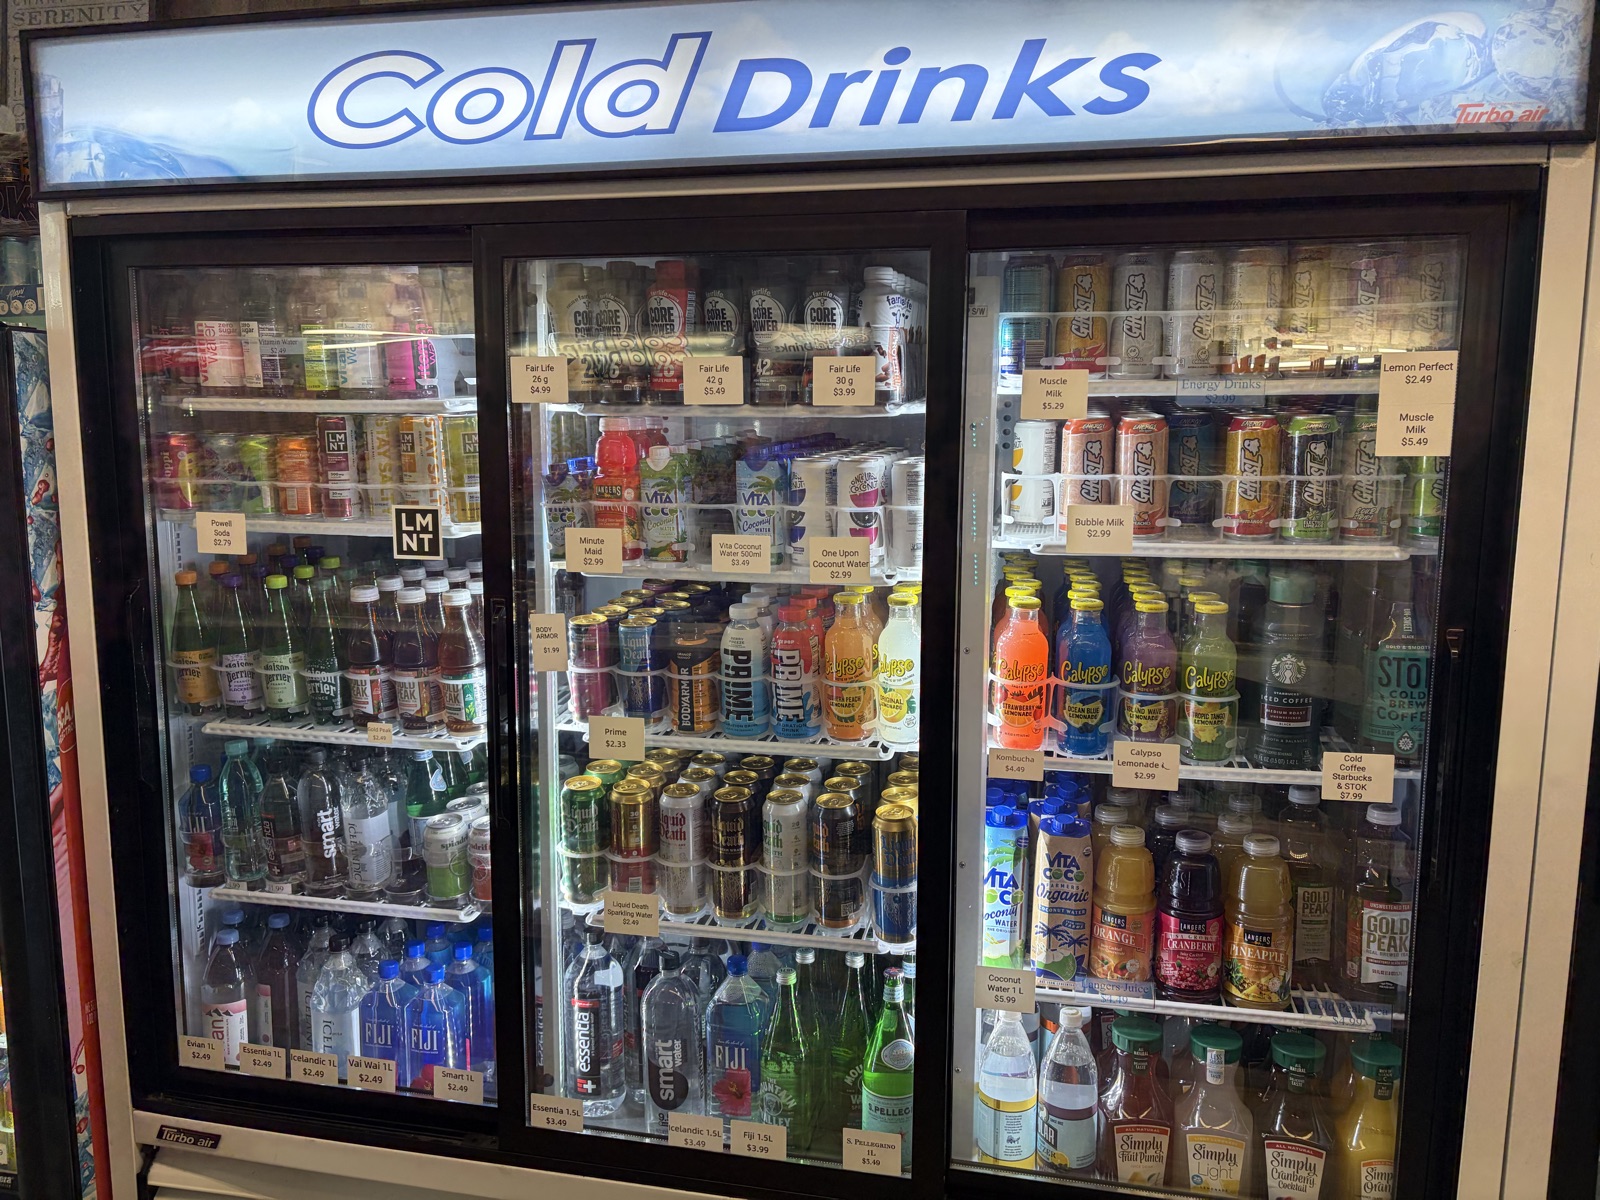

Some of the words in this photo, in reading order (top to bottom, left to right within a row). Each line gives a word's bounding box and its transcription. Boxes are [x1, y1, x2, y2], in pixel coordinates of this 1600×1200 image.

[12, 2, 147, 27] SERENITY
[307, 31, 712, 150] Cold
[712, 38, 1163, 133] Drinks
[1455, 103, 1514, 124] Turbo
[1517, 105, 1549, 123] air
[526, 364, 539, 372] Fair
[540, 364, 554, 372] Life
[699, 364, 714, 372] Fair
[715, 364, 730, 372] Life
[829, 364, 844, 373] Fair
[846, 364, 861, 372] Life
[1384, 364, 1416, 372] Lemon
[1419, 362, 1454, 371] Perfect
[532, 375, 542, 383] 26
[543, 376, 548, 384] g
[706, 376, 716, 384] 42
[717, 378, 723, 386] g
[836, 376, 846, 384] 30
[848, 378, 854, 386] g
[1182, 379, 1220, 392] Energy
[1224, 377, 1262, 390] Drinks
[1405, 375, 1432, 384] $2.49
[530, 386, 551, 395] $4.99
[704, 387, 726, 396] $5.49
[833, 388, 856, 396] $3.99
[1204, 394, 1236, 404] $2.99
[1042, 402, 1064, 410] $5.29
[1399, 413, 1434, 422] Muscle
[1406, 426, 1426, 434] Milk
[1401, 437, 1428, 446] $5.49
[211, 519, 232, 527] Powell
[1075, 518, 1104, 526] Bubble
[1106, 518, 1124, 526] Milk
[214, 529, 230, 537] Soda
[1087, 530, 1111, 538] $2.99
[213, 539, 232, 547] $2.79
[579, 537, 605, 545] Minute
[719, 542, 733, 550] Vita
[734, 543, 762, 551] Coconut
[720, 550, 739, 558] Water
[822, 549, 838, 557] One
[839, 550, 859, 559] Upon
[583, 558, 604, 566] $2.99
[731, 559, 750, 567] $3.49
[812, 560, 844, 568] Coconut
[846, 560, 869, 568] Water
[830, 571, 852, 579] $2.99
[998, 660, 1044, 683] Calypso
[1061, 660, 1108, 685] Calypso
[1123, 661, 1171, 687] Calypso
[1185, 666, 1234, 692] Calypso
[724, 648, 754, 722] PRIME
[773, 649, 805, 722] PRIME
[604, 728, 627, 736] Prime
[605, 740, 626, 748] $2.33
[996, 754, 1034, 763] Kombucha
[1130, 749, 1162, 758] Calypso
[1005, 765, 1025, 773] $4.49
[1118, 760, 1159, 768] Lemonade
[1339, 764, 1366, 772] Coffee
[1134, 772, 1156, 780] $2.99
[1332, 773, 1372, 782] Starbucks
[1340, 792, 1362, 800] $7.99
[1046, 851, 1081, 872] VITA
[1043, 867, 1085, 883] COCO
[1036, 883, 1090, 904] Organic
[612, 902, 630, 910] Liquid
[607, 909, 634, 918] Sparkling
[622, 918, 639, 926] $2.49
[1102, 914, 1125, 926] LANGERS
[1180, 922, 1205, 933] LANGERS
[1366, 916, 1410, 935] GOLD
[1093, 924, 1136, 945] ORANGE
[1244, 933, 1271, 944] LANGERS
[1167, 939, 1216, 952] CRANBERRY
[1366, 933, 1409, 953] PEAK
[1230, 944, 1285, 963] PINEAPPLE
[988, 974, 1021, 984] Coconut
[988, 984, 1010, 994] Water
[1081, 979, 1120, 992] Langers
[1122, 983, 1149, 994] Juice
[994, 994, 1016, 1004] $5.99
[1100, 994, 1128, 1004] $4.49
[1368, 1004, 1388, 1016] Tea
[365, 1023, 391, 1045] FIJI
[187, 1040, 206, 1049] Evian
[411, 1028, 438, 1051] FIJI
[576, 1012, 592, 1073] essentia
[192, 1051, 211, 1060] $2.49
[243, 1047, 272, 1056] Essentia
[674, 1038, 682, 1067] water
[252, 1059, 272, 1067] $2.49
[291, 1054, 326, 1066] Icelandic
[714, 1045, 747, 1071] FIJI
[348, 1059, 362, 1068] Vai
[364, 1061, 380, 1070] Wai
[383, 1063, 392, 1071] 1L
[658, 1039, 674, 1101] smart
[303, 1068, 324, 1078] $2.49
[442, 1071, 464, 1080] Smart
[466, 1074, 474, 1082] 1L
[358, 1074, 382, 1084] $2.49
[448, 1083, 468, 1092] $2.49
[532, 1104, 564, 1114] Essentia
[566, 1109, 580, 1117] 1.5L
[546, 1117, 567, 1126] $3.49
[669, 1125, 704, 1135] Icelandic
[706, 1129, 722, 1138] 1.5L
[162, 1127, 195, 1145] Turbo
[197, 1137, 215, 1149] air
[743, 1132, 755, 1141] Fiji
[757, 1134, 773, 1142] 1.5L
[684, 1138, 706, 1147] $3.49
[1120, 1134, 1164, 1154] Simply
[746, 1144, 769, 1153] $3.99
[1118, 1152, 1138, 1163] Fruit
[1138, 1153, 1164, 1163] Punch
[1192, 1143, 1239, 1167] Simply
[1270, 1150, 1318, 1177] Simply
[1198, 1162, 1233, 1180] Light
[1271, 1168, 1315, 1188] Cranberry
[1278, 1181, 1308, 1193] Cocktail
